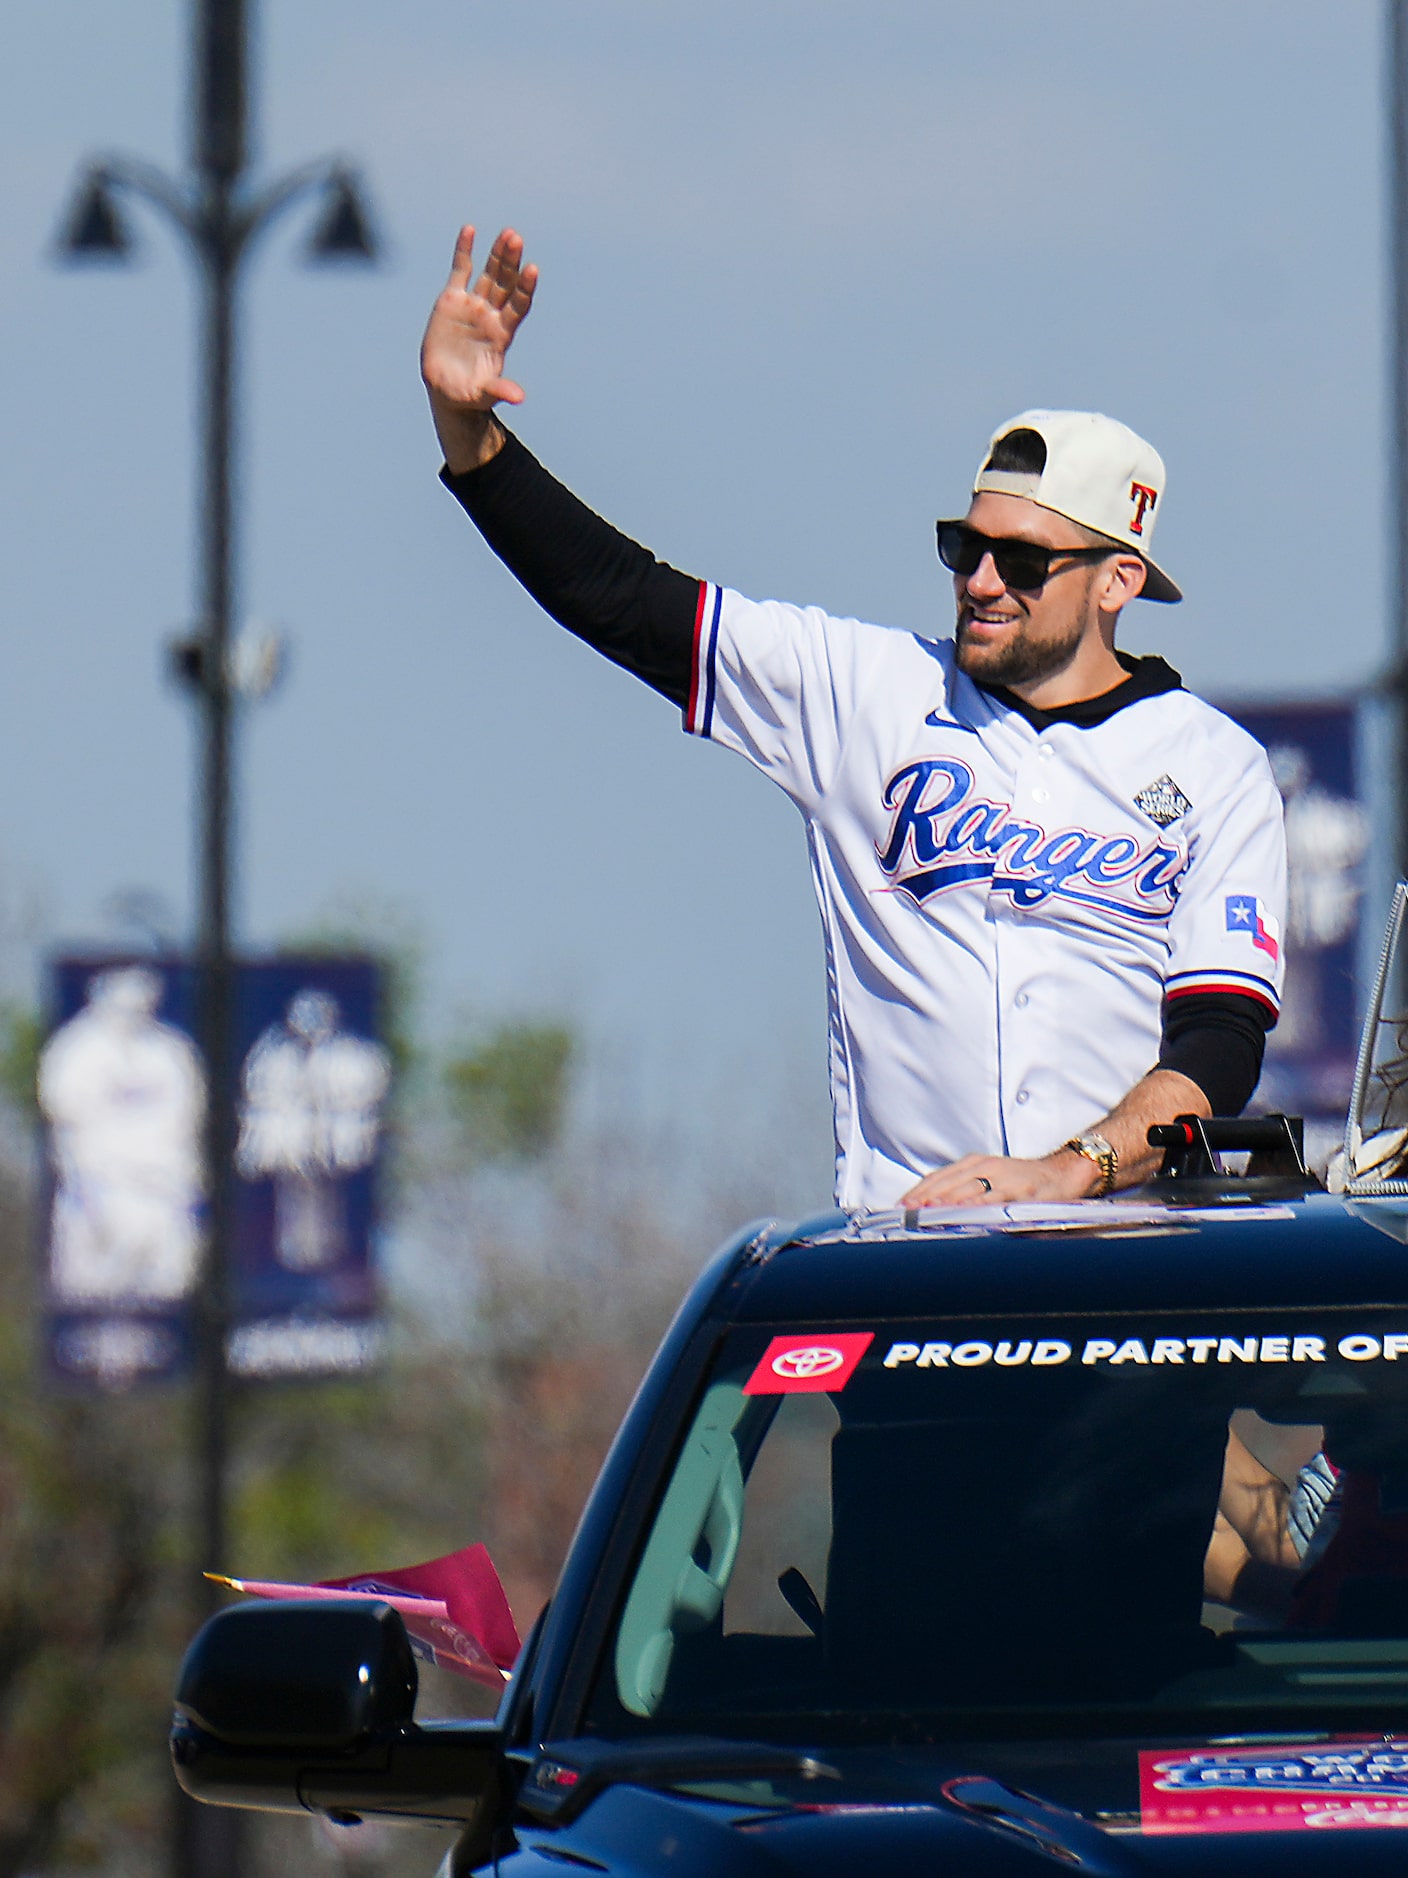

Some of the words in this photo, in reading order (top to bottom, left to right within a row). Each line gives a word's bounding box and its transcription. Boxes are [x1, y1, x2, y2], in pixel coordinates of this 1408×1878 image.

[1129, 480, 1157, 537] T
[1138, 790, 1186, 806] WORLD
[882, 1341, 1072, 1368] PROUD
[1081, 1336, 1327, 1365] PARTNER
